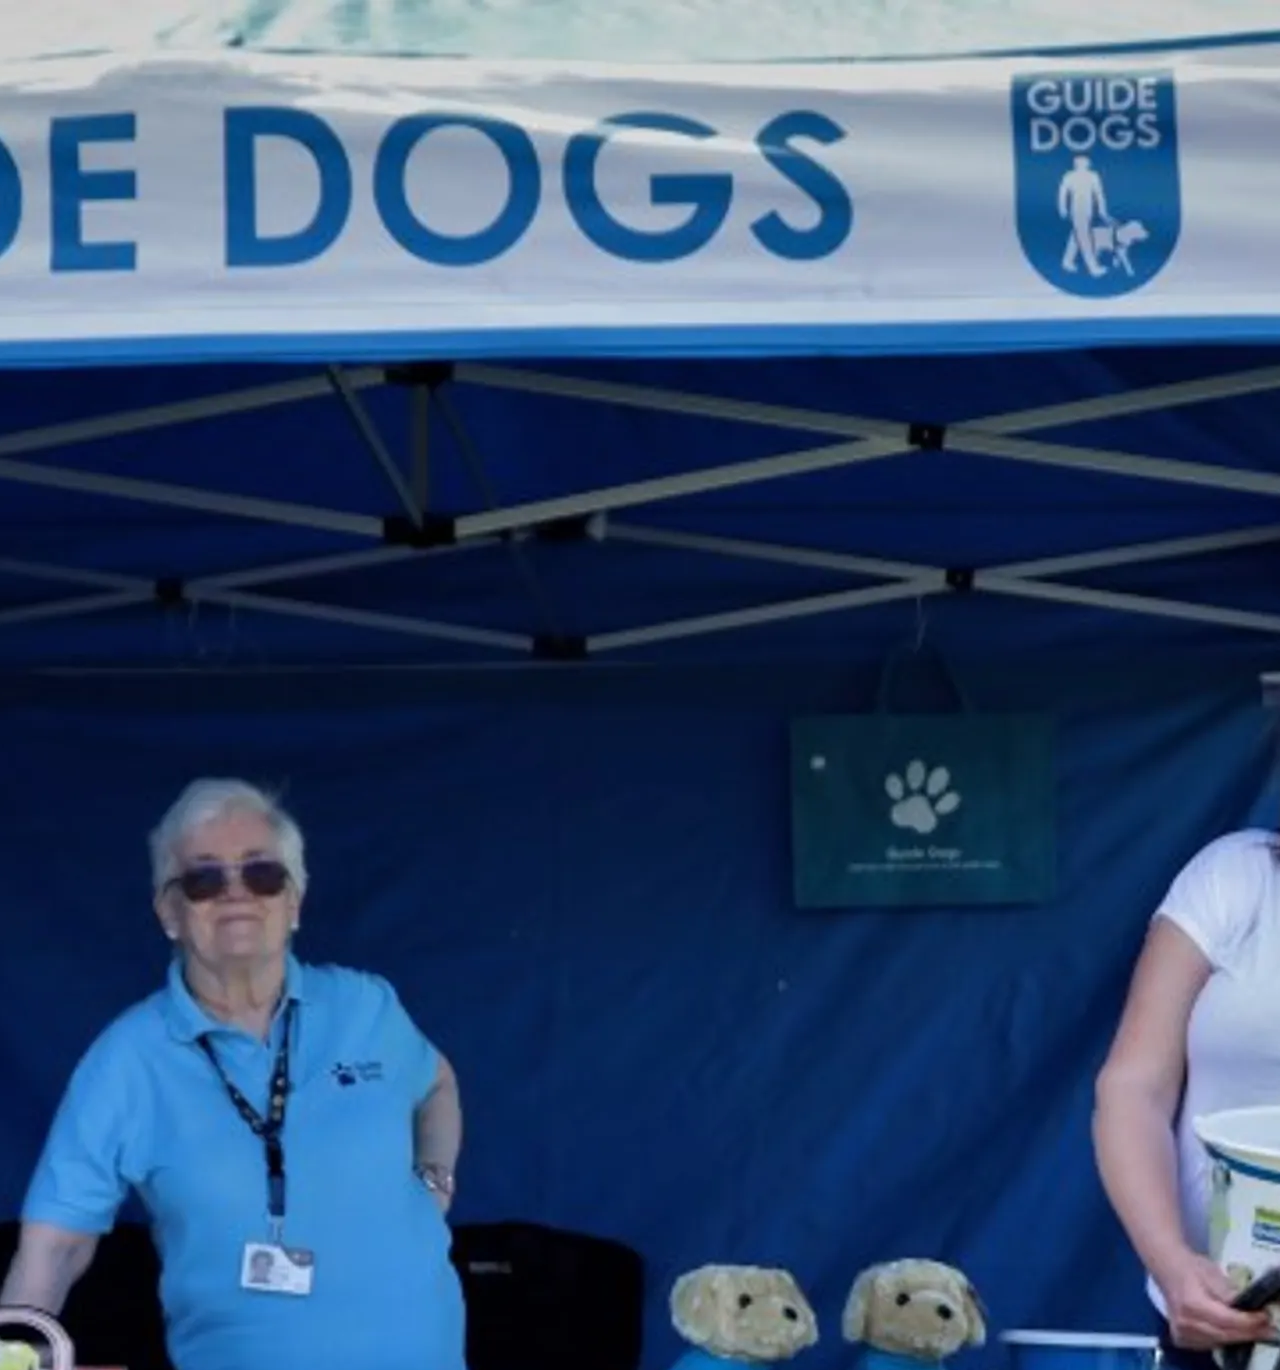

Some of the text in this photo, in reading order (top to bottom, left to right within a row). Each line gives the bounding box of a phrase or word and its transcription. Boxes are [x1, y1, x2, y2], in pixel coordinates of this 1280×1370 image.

[1026, 77, 1158, 116] GUIDE
[1030, 112, 1161, 153] DOGS
[223, 105, 854, 268] DOGS
